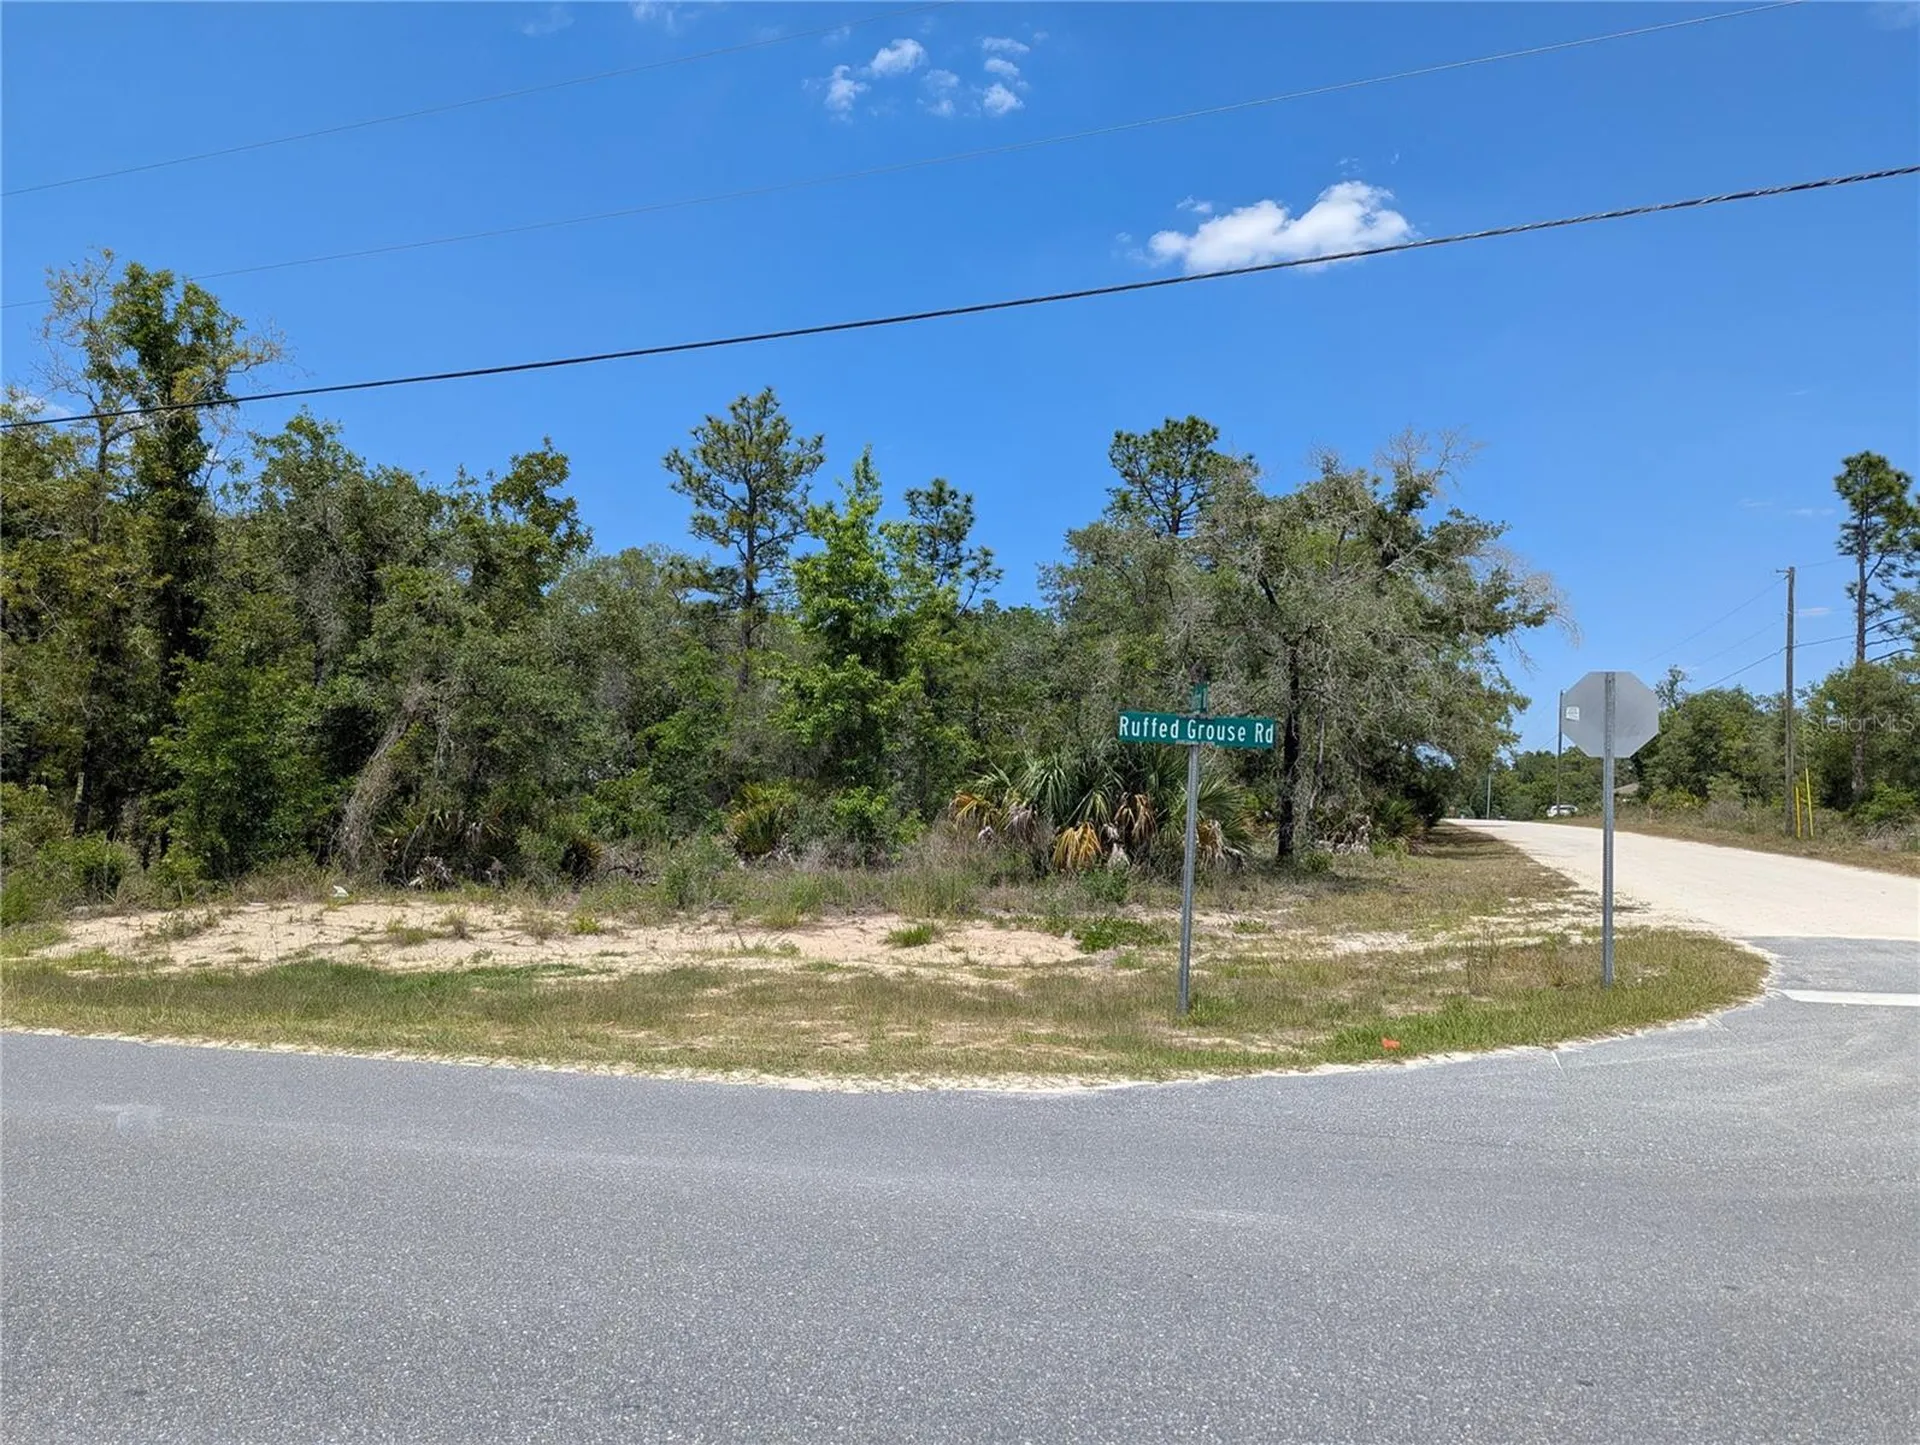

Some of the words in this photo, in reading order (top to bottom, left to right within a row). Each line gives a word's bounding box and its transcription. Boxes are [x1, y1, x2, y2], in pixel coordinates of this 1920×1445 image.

[1119, 715, 1179, 739] Ruffed
[1187, 719, 1246, 742] Grouse
[1254, 722, 1274, 743] Rd
